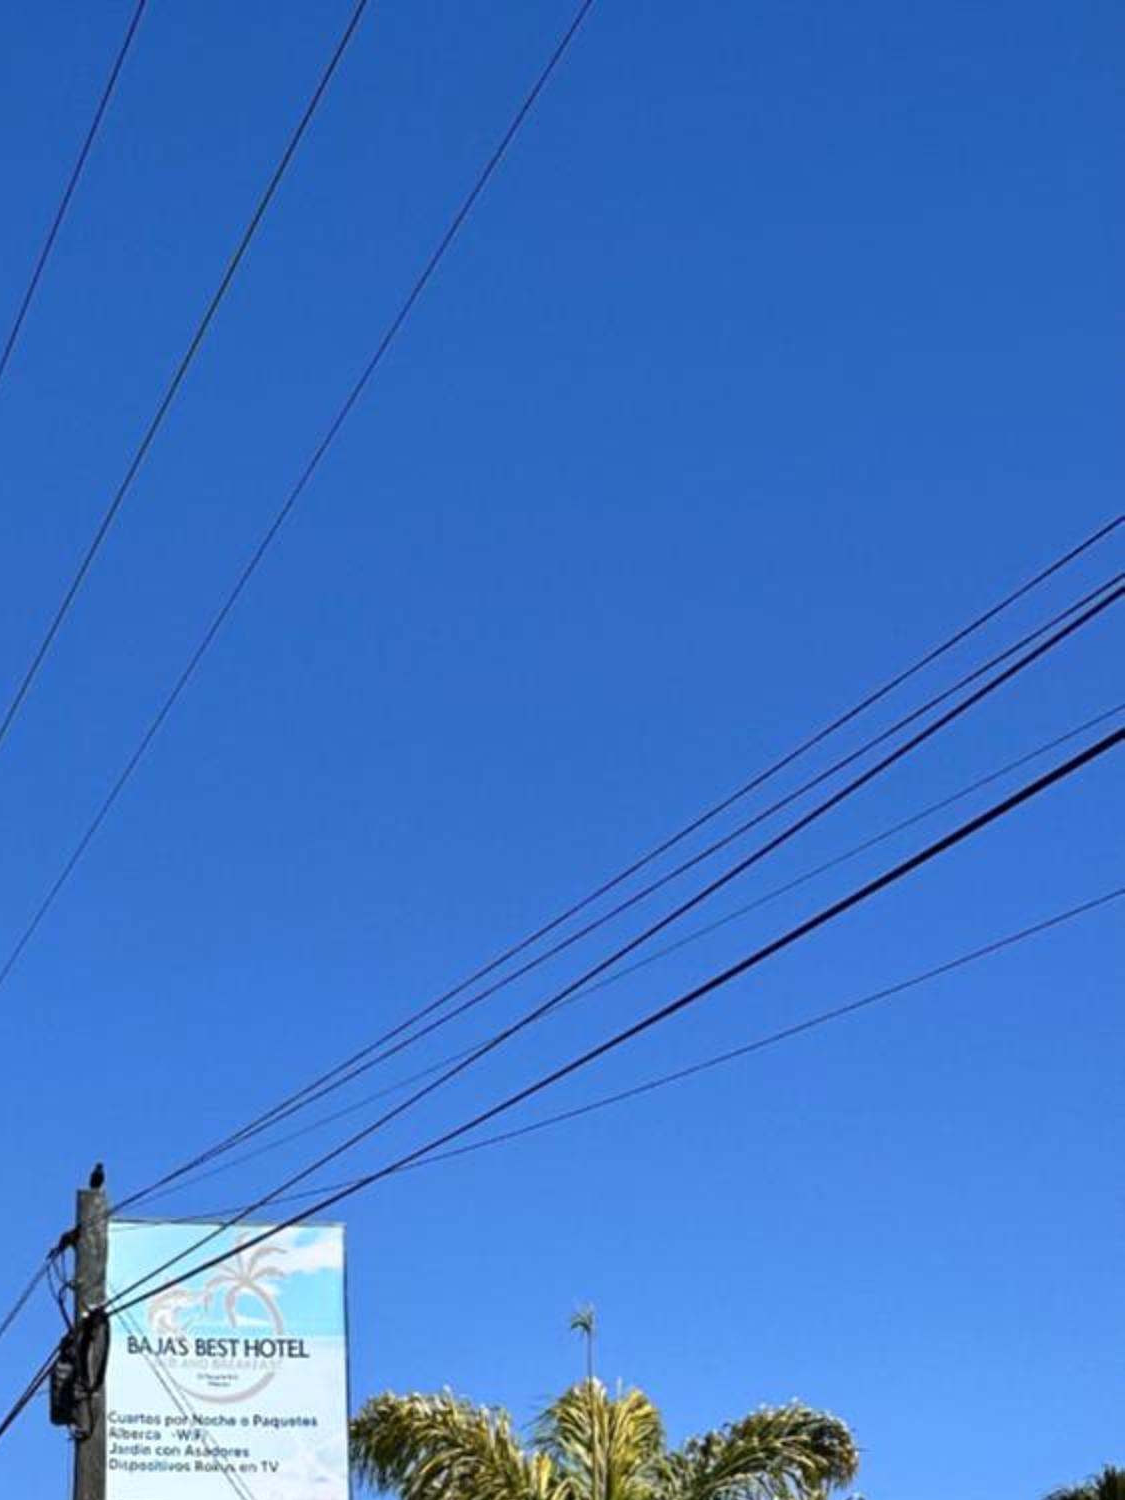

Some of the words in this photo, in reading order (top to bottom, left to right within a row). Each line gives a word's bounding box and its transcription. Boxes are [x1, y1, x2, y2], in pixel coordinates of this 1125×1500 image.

[195, 1338, 239, 1358] BEST
[244, 1339, 309, 1358] HOTEL
[107, 1411, 161, 1425] Cuartos
[165, 1414, 187, 1427] por
[193, 1414, 236, 1426] Noche
[253, 1414, 317, 1429] Paquetes
[108, 1427, 161, 1440] Alberca
[155, 1446, 181, 1457] con
[184, 1444, 249, 1458] Asadores
[109, 1459, 191, 1473] Dispositivos
[239, 1463, 257, 1472] en
[262, 1461, 279, 1472] TV
